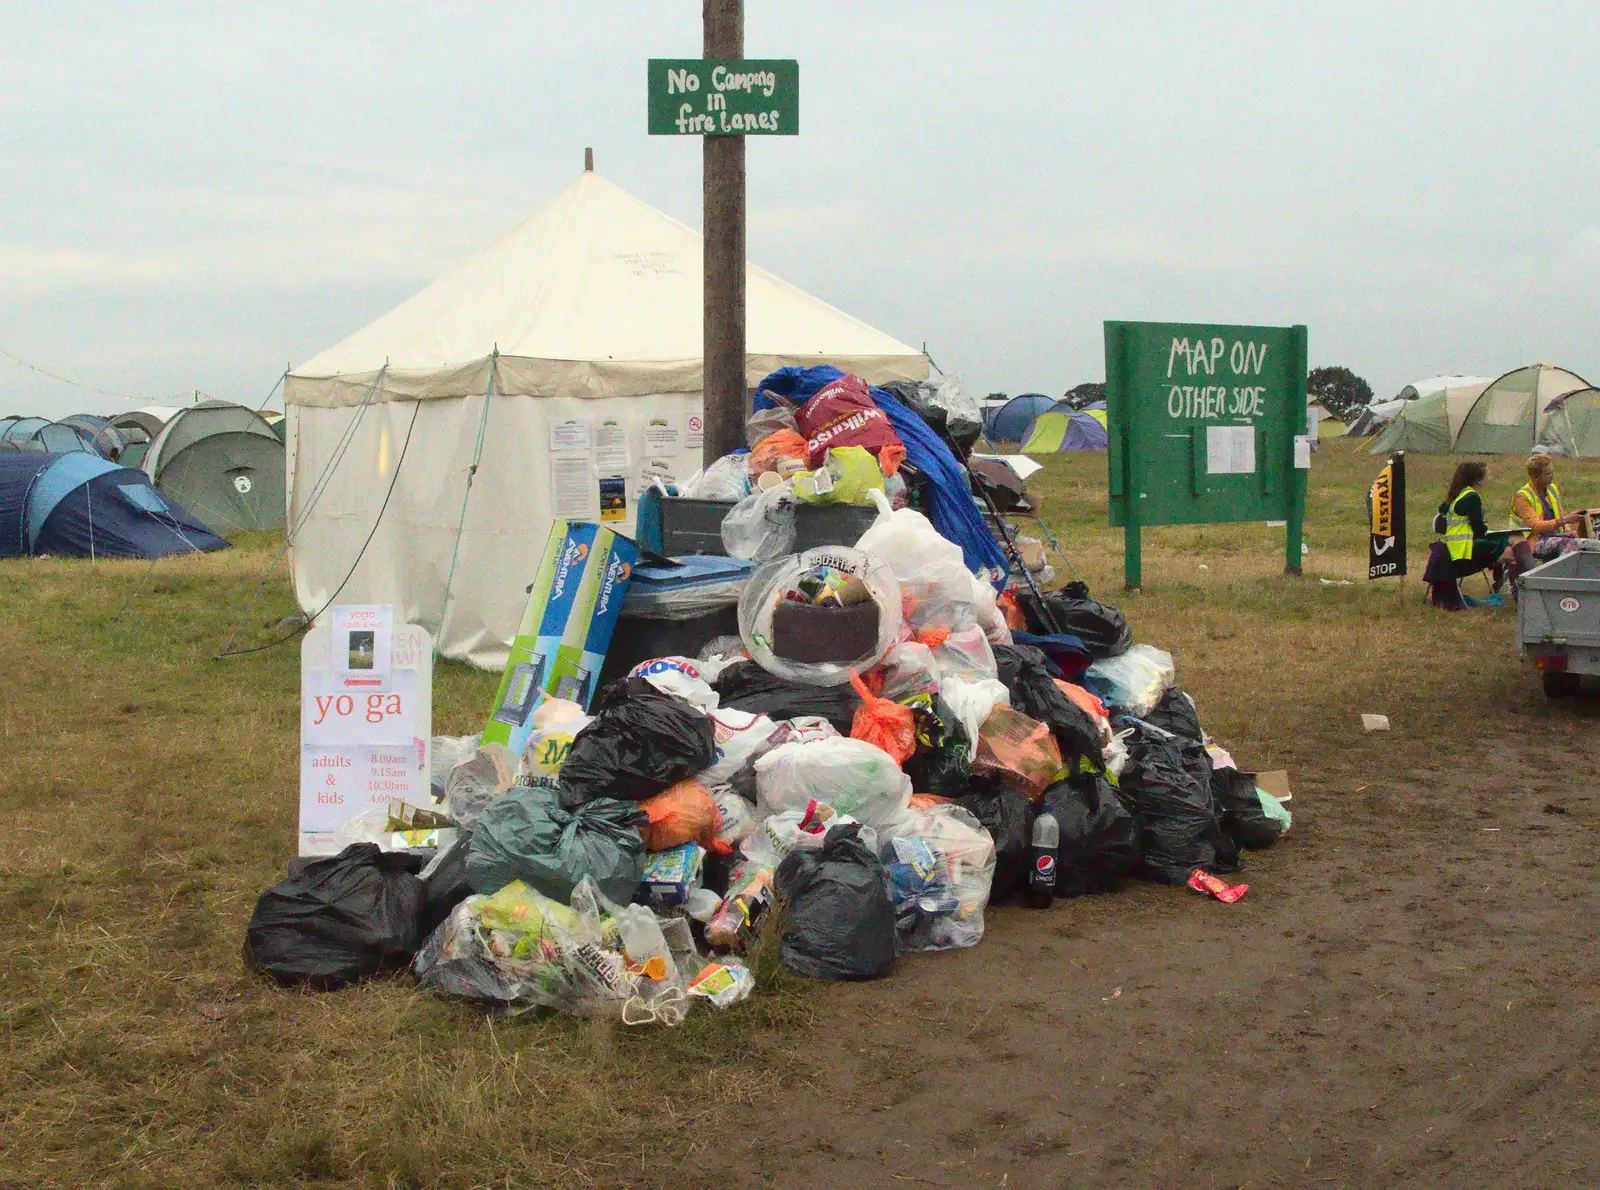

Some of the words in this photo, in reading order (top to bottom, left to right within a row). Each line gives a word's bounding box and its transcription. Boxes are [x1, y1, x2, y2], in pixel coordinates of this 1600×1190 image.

[667, 68, 700, 95] No
[711, 65, 776, 97] Camping
[707, 93, 727, 111] in
[674, 102, 716, 133] fire
[1166, 337, 1225, 378] MAP
[1230, 340, 1268, 375] ON
[1167, 384, 1226, 420] OTHER
[1228, 386, 1267, 417] SIDE
[1377, 473, 1389, 532] FESTAXI
[552, 538, 577, 601] AVENTURA
[1369, 562, 1397, 577] STOP
[597, 551, 621, 616] AVENTURA
[350, 611, 376, 620] yoga
[312, 755, 352, 769] adults
[371, 754, 407, 764] 8.00am
[325, 773, 337, 786] &
[371, 768, 407, 777] 9.15am
[368, 780, 409, 791] 10.30am
[317, 791, 345, 804] kids
